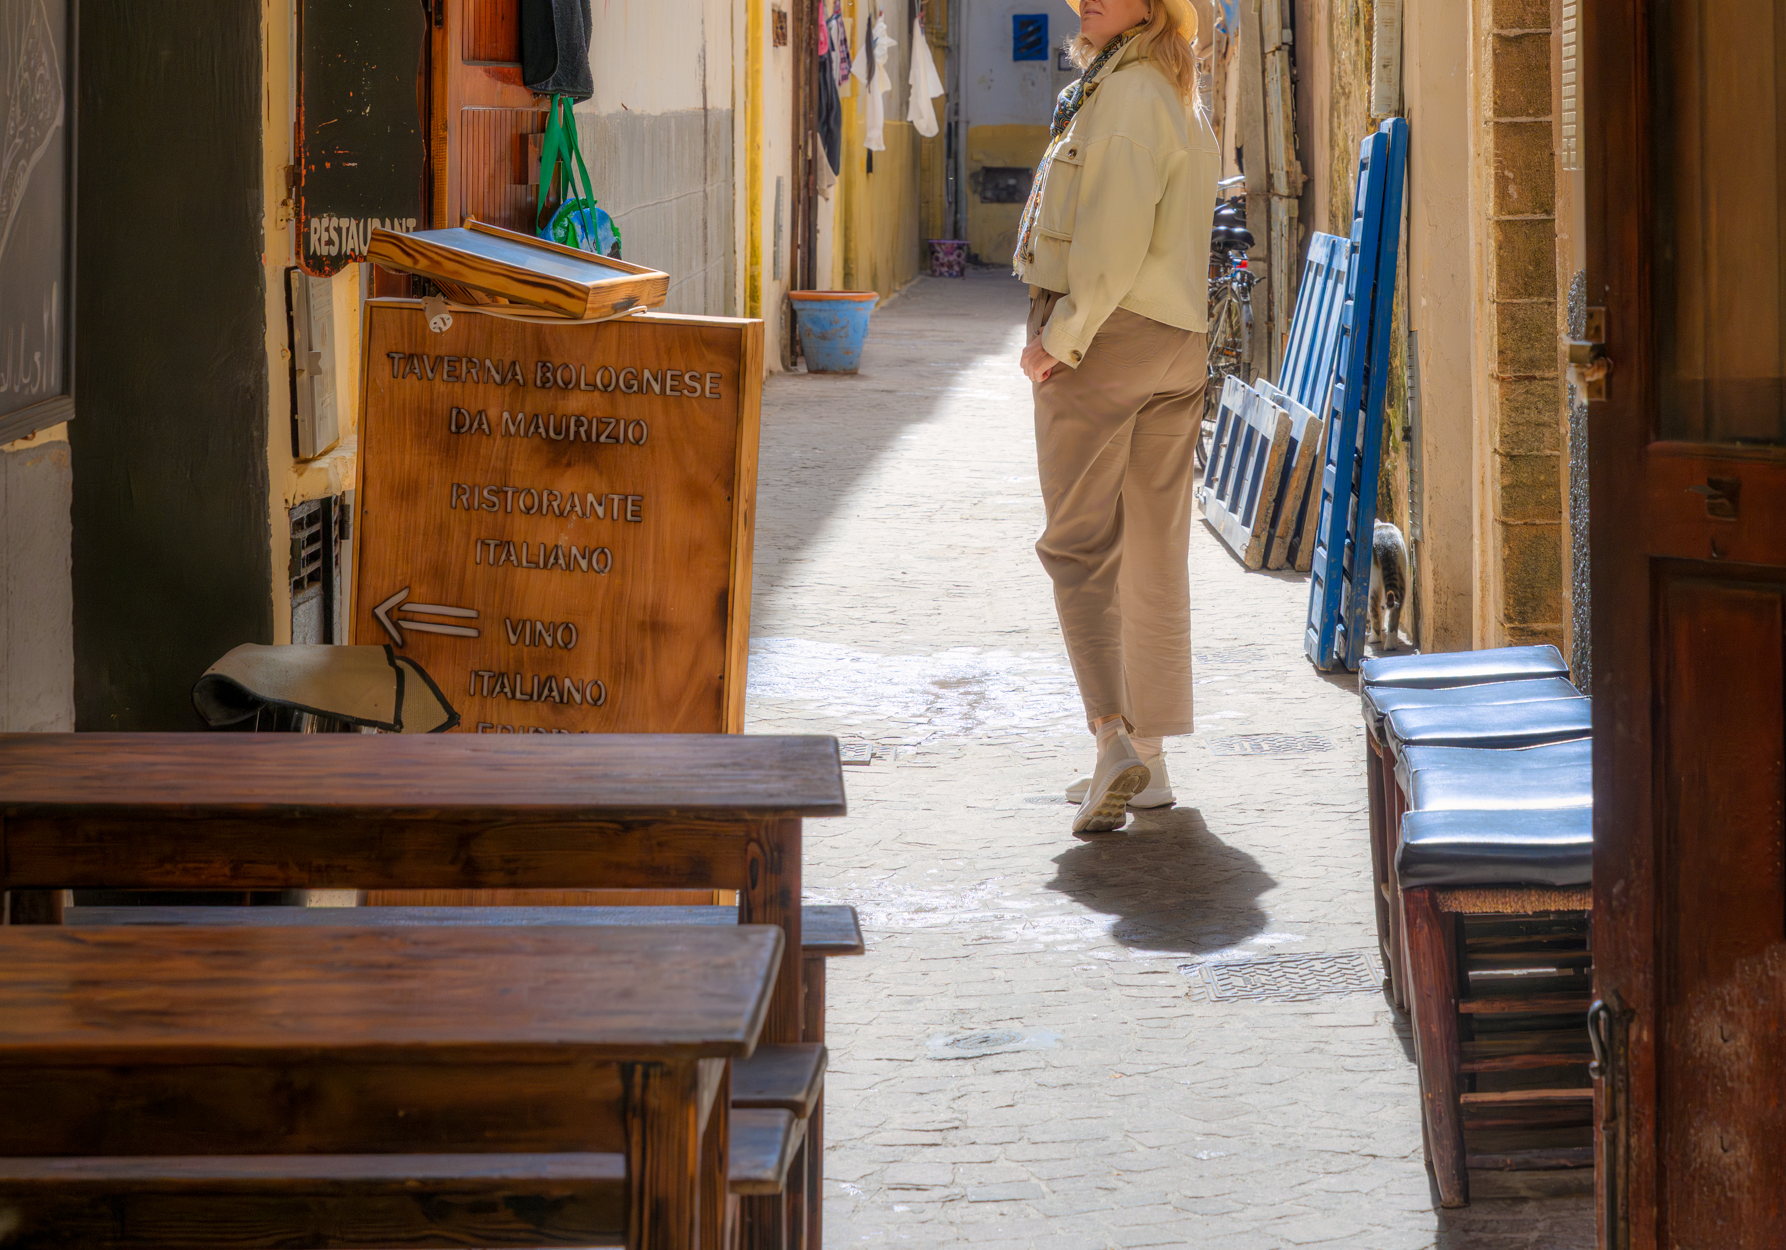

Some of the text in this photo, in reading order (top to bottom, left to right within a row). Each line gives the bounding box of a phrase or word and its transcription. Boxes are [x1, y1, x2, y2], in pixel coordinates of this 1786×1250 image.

[310, 217, 417, 256] RESTAU
[387, 351, 722, 400] TAVERNA BOLOGNESE
[449, 406, 649, 446] DA MAURIZIO
[450, 482, 644, 523] RISTORANTE
[475, 538, 613, 574] ITALIANO
[504, 617, 578, 650] VINO
[468, 669, 607, 706] ITALIANO
